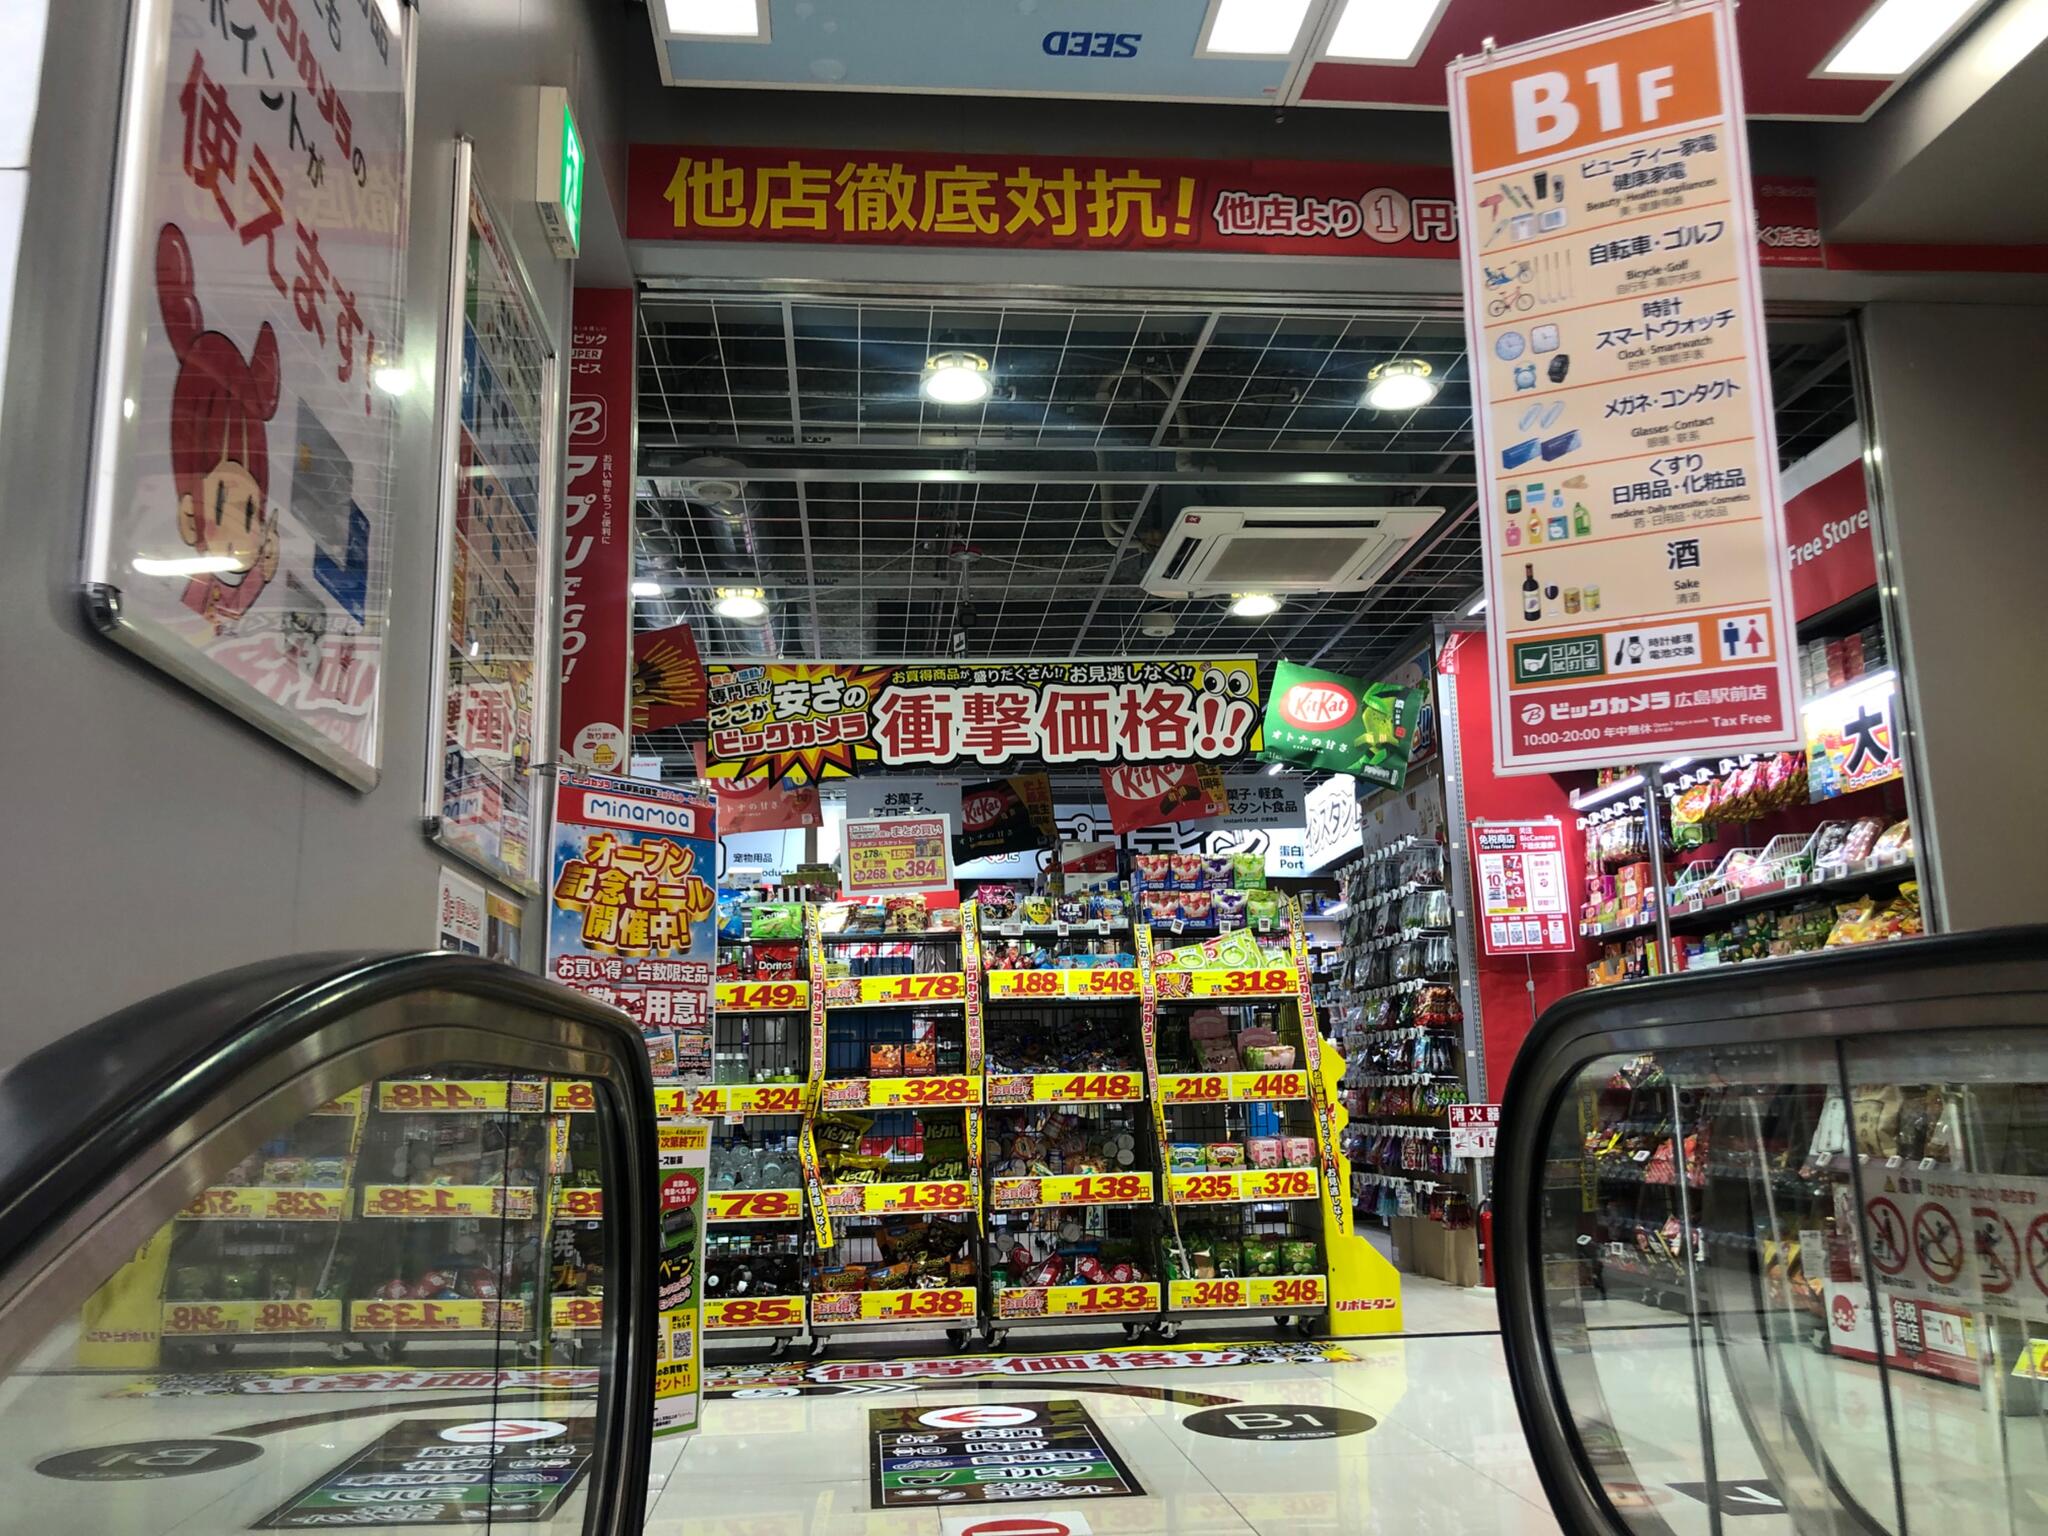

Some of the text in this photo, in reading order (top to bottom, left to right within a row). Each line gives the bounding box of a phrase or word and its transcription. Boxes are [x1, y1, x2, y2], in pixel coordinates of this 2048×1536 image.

[1043, 31, 1141, 58] SEED
[1512, 62, 1675, 155] B1F
[664, 157, 1195, 238] 他店徹底対抗!
[1642, 297, 1682, 318] 時計
[1596, 309, 1736, 350] スマートウォッチ
[1604, 378, 1741, 418] メガネ・コンタクト
[1649, 454, 1704, 477] くすり
[1612, 468, 1746, 505] 日用品・化粧品
[1822, 509, 1869, 551] Store
[1667, 539, 1700, 571] 酒
[1674, 579, 1700, 591] Sake
[711, 702, 770, 729] ここが
[1294, 690, 1346, 721] KitKat
[1549, 685, 1768, 721] ビックカメラ 広島駅前店
[714, 713, 868, 757] ビックカメラ
[880, 688, 1248, 758] 衝撃価格!!
[1523, 728, 1601, 747] 10:00-20:00
[1711, 716, 1737, 728] Tax
[1740, 713, 1772, 725] Free
[884, 792, 924, 804] お菓子
[586, 833, 694, 878] オープン
[583, 906, 692, 950] 開催中!
[1452, 1107, 1500, 1122] 消火器
[1224, 1412, 1325, 1430] B1
